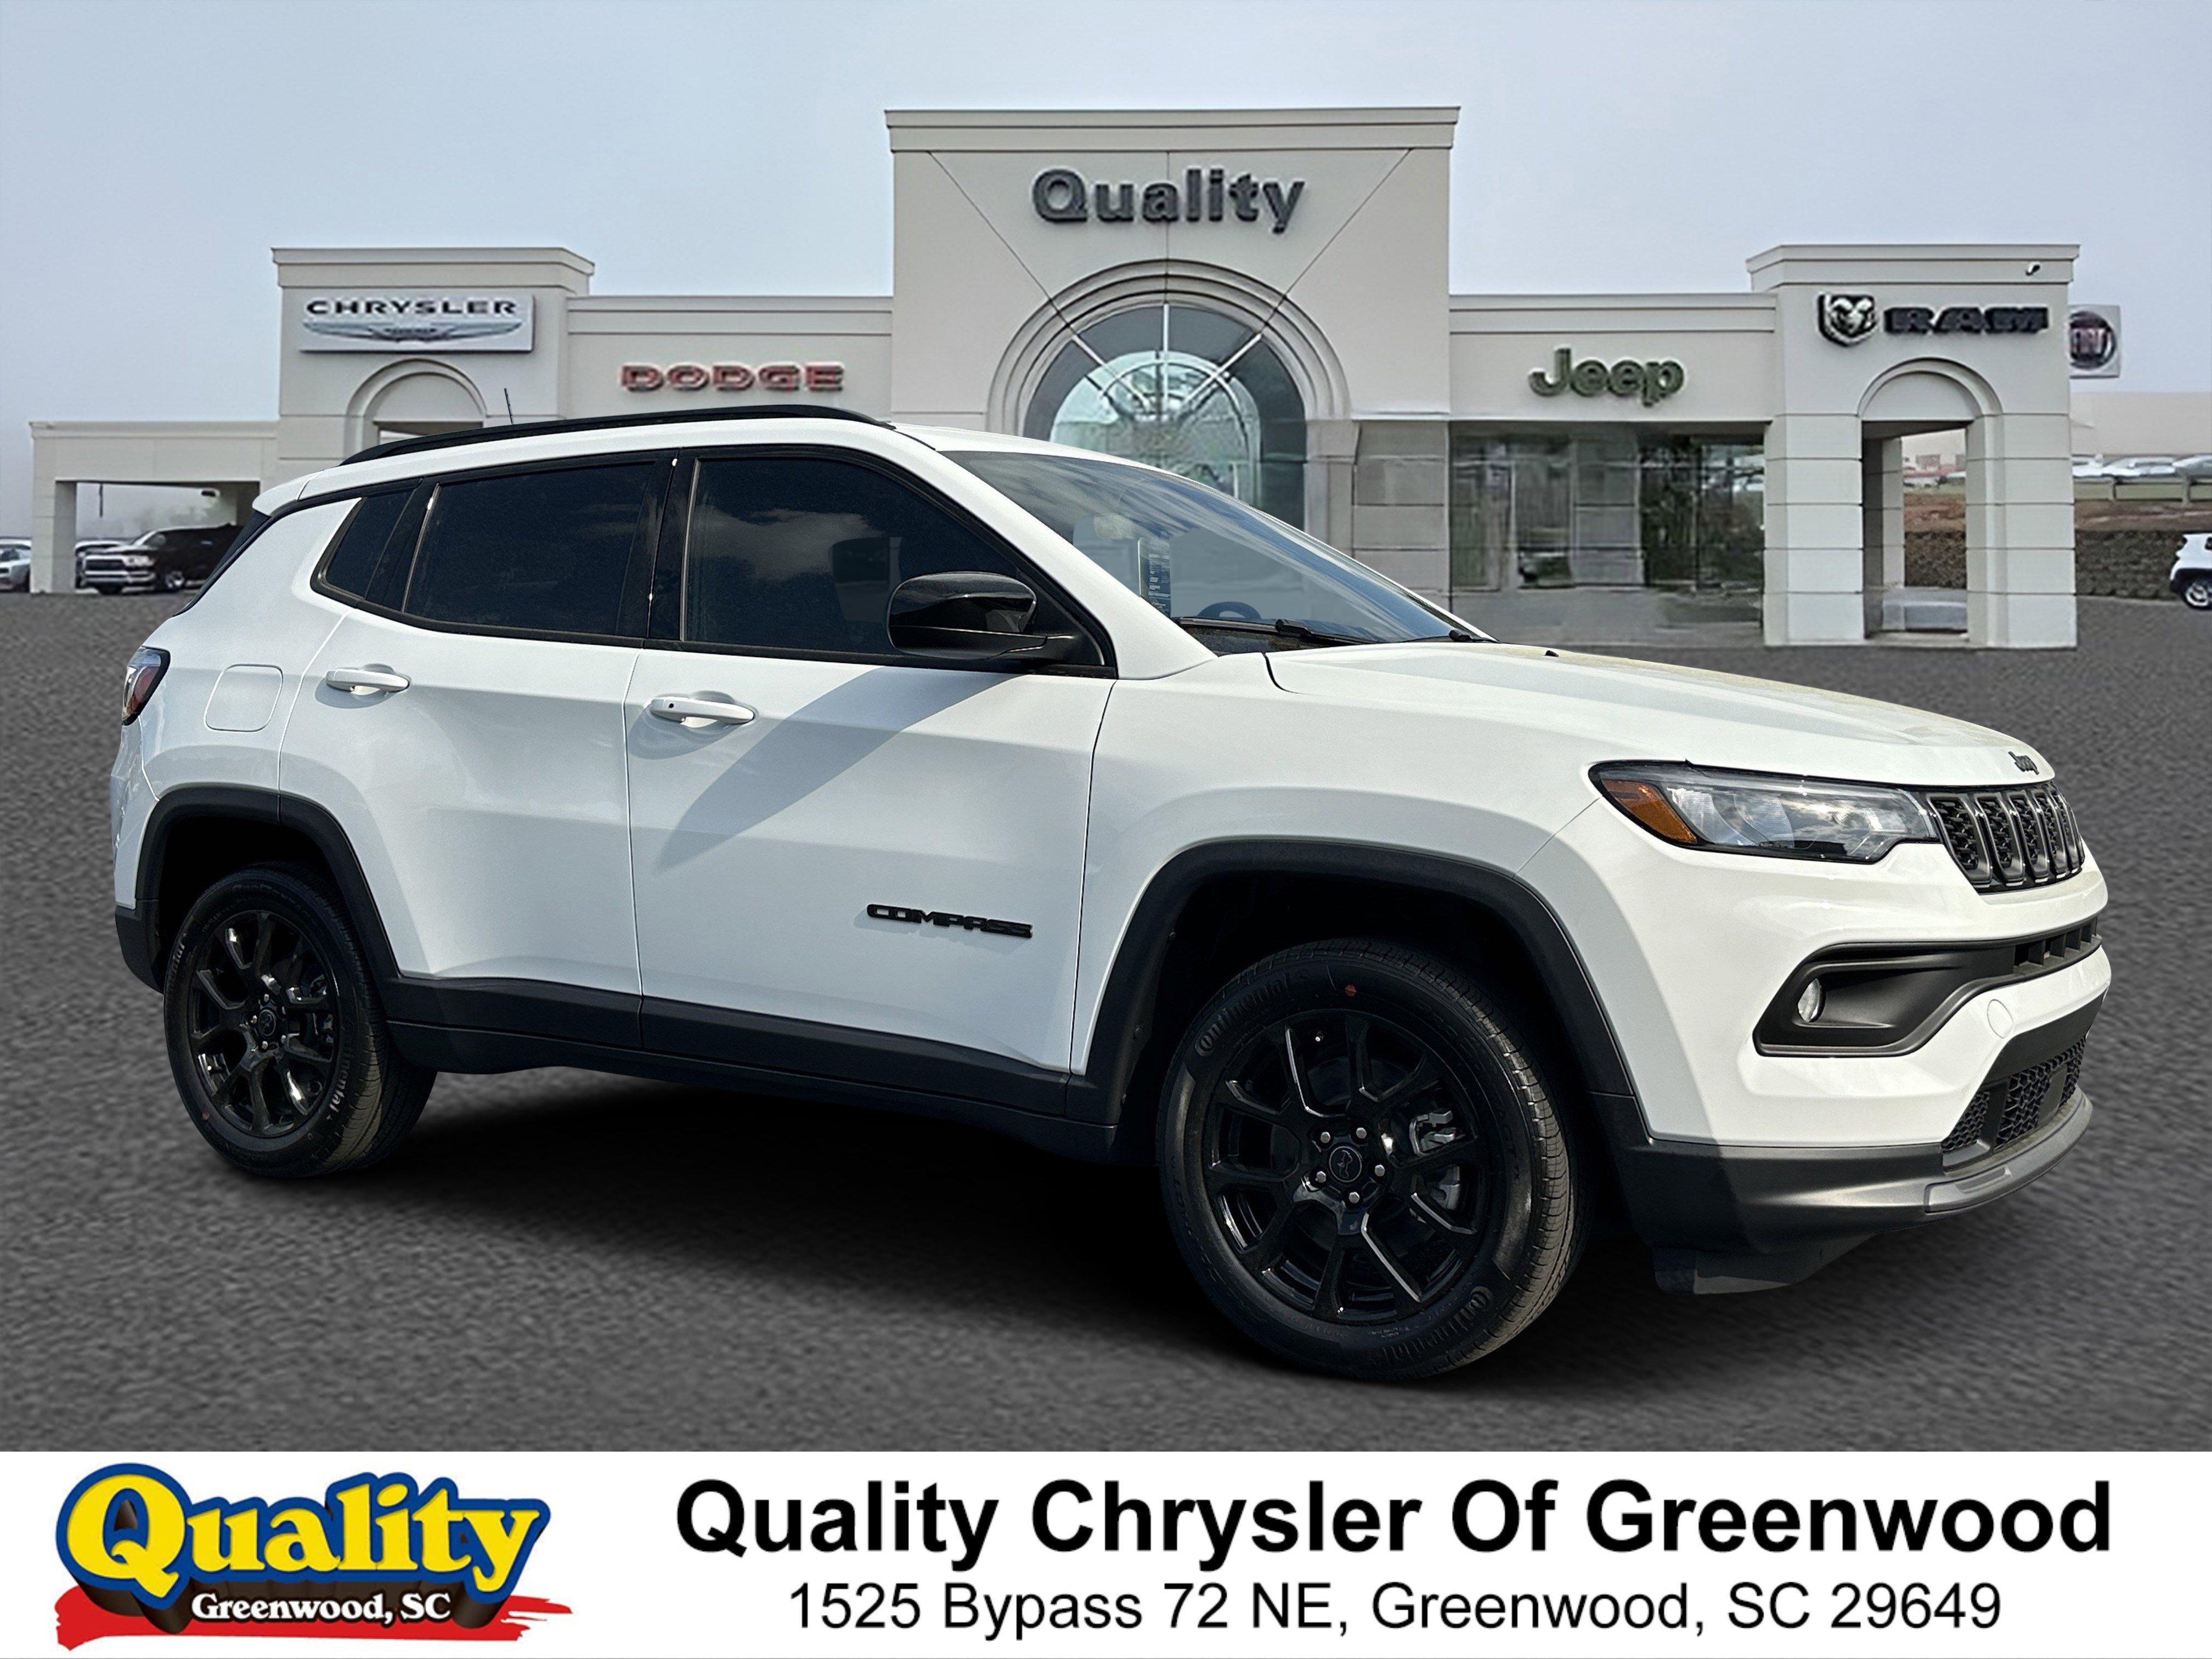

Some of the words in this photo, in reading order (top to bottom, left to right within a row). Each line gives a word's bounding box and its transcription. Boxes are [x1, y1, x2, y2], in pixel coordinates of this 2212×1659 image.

[1032, 168, 1305, 234] Quality
[306, 300, 517, 315] CHRYSLER
[1883, 306, 2049, 334] RAM
[620, 364, 844, 392] DODGE
[1528, 347, 1685, 408] Jeep
[866, 904, 1032, 939] COMPASS
